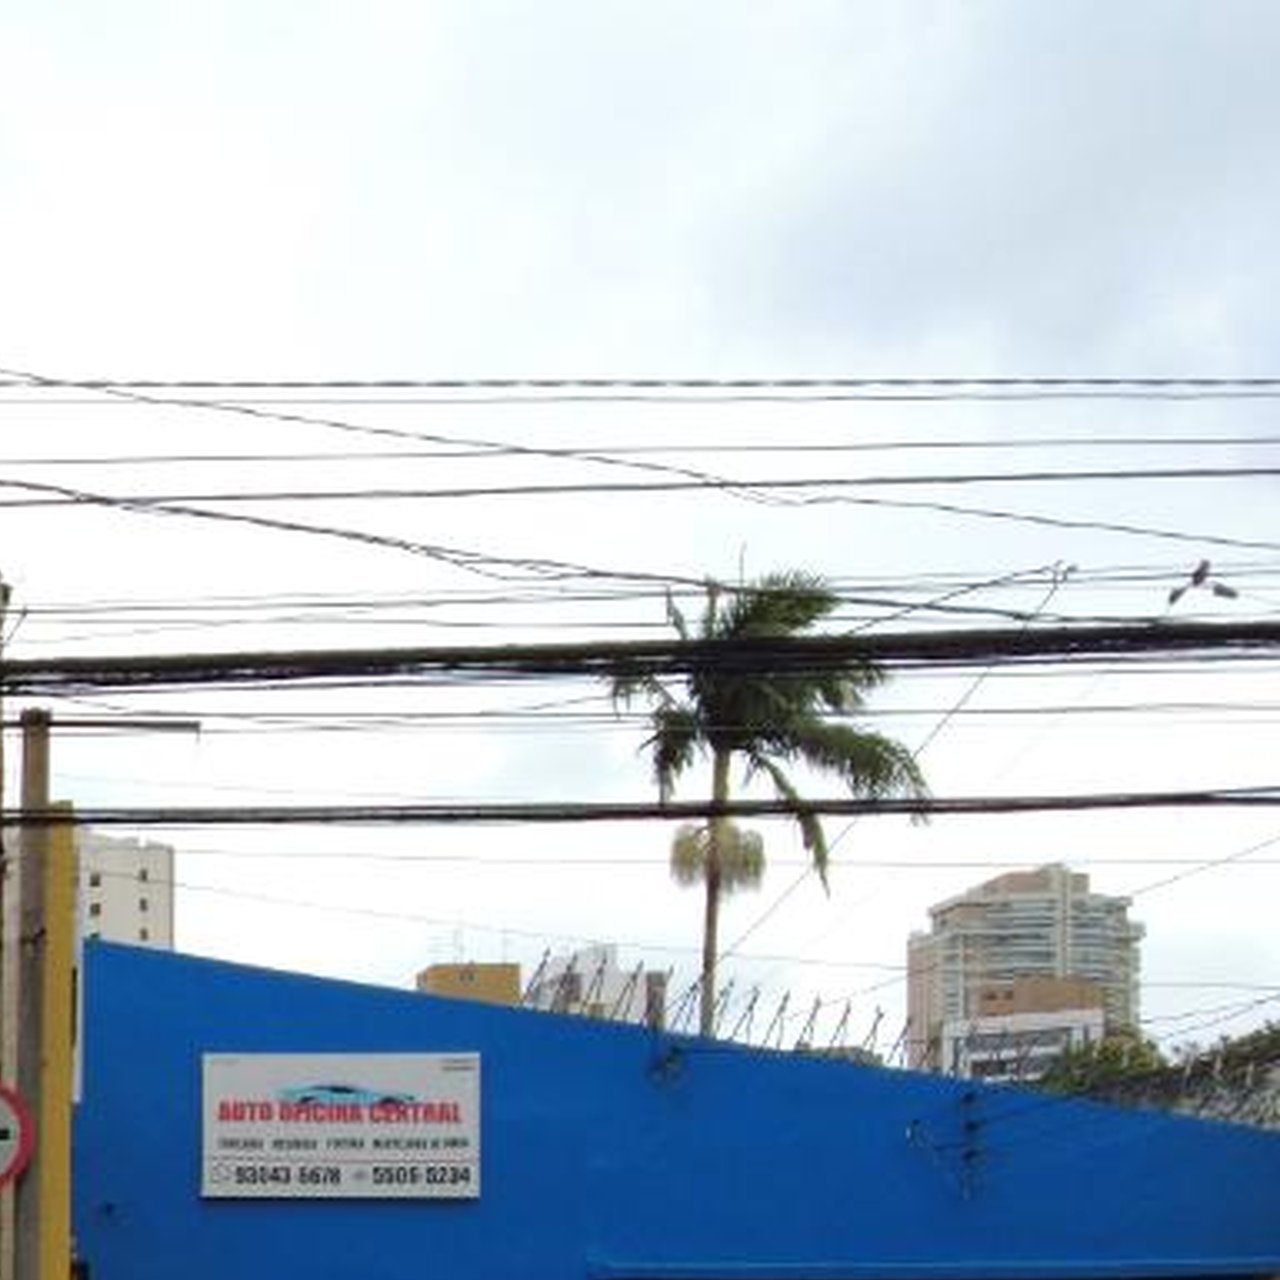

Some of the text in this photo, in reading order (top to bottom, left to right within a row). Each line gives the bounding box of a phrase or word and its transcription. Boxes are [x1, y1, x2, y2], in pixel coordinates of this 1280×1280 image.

[218, 1101, 463, 1123] AUTO OFICINA CENTRAL
